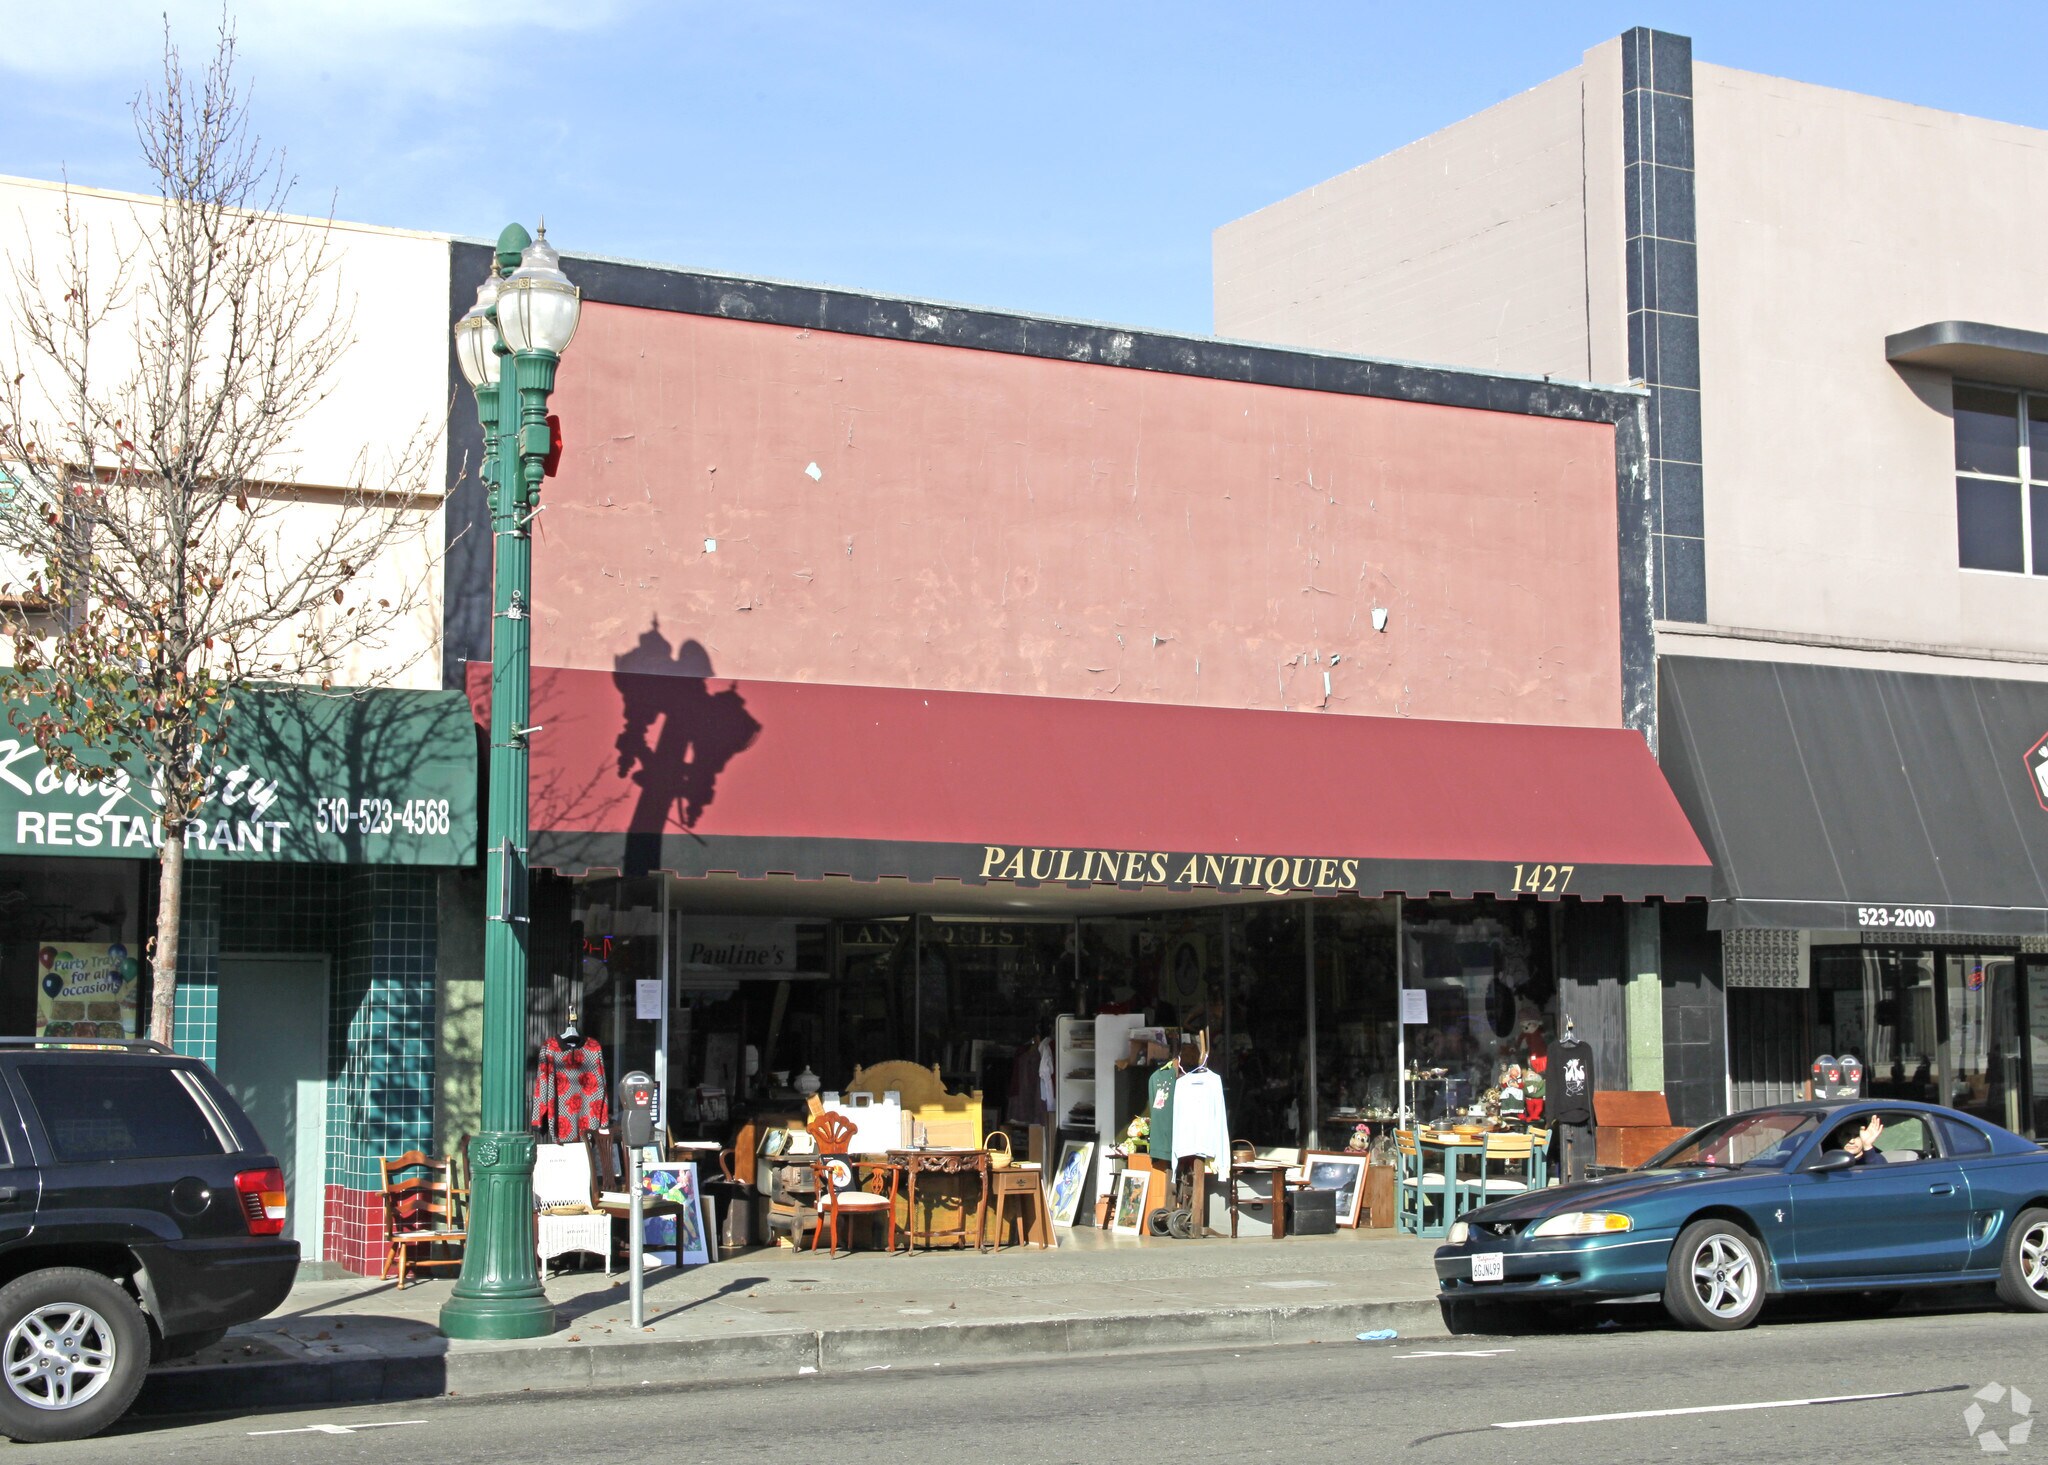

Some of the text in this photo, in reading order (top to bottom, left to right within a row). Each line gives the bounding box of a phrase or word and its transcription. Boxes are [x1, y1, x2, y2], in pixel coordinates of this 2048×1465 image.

[315, 797, 451, 836] 510-523-4568
[979, 846, 1360, 895] PAULINES ANTIQUES
[1510, 864, 1575, 893] 1427
[1857, 907, 1936, 928] 523-2000
[856, 924, 1014, 945] ANQUES
[54, 958, 88, 971] Party
[690, 942, 784, 966] Pauline's
[71, 968, 109, 984] for all
[62, 981, 120, 997] occasions
[1474, 1263, 1501, 1277] 6GJN499
